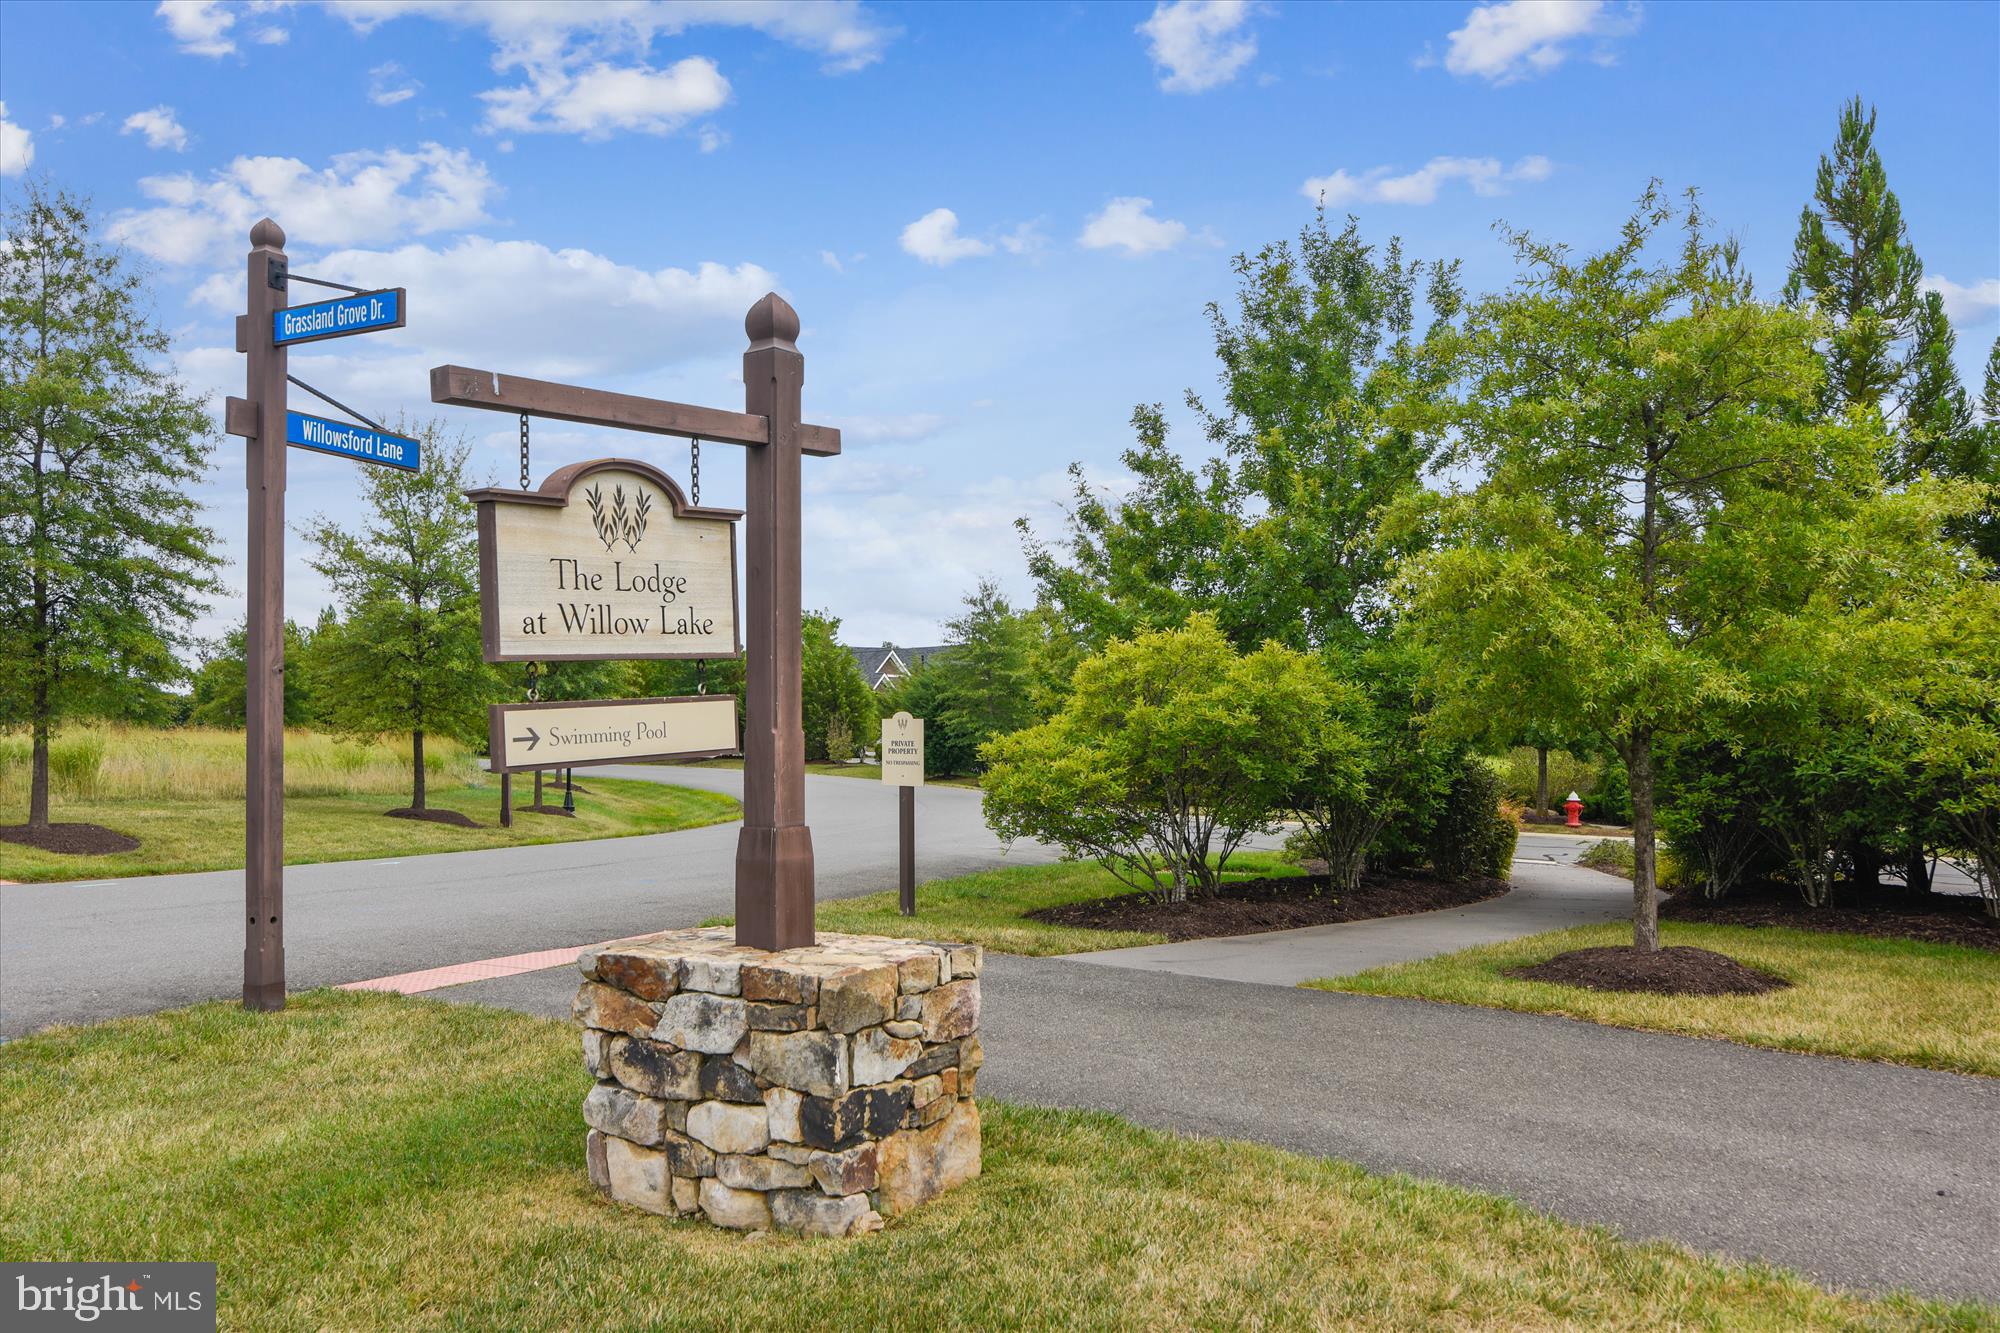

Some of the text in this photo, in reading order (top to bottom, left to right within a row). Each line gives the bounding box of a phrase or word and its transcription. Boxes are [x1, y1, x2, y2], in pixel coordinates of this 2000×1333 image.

[284, 298, 385, 336] Grassland Grove Dr.
[302, 419, 403, 461] Willowsford Lane
[550, 558, 687, 603] The Lodge
[522, 603, 714, 635] at Willow Lake
[549, 721, 667, 748] Swimming Pool
[887, 747, 918, 755] PROPERTY
